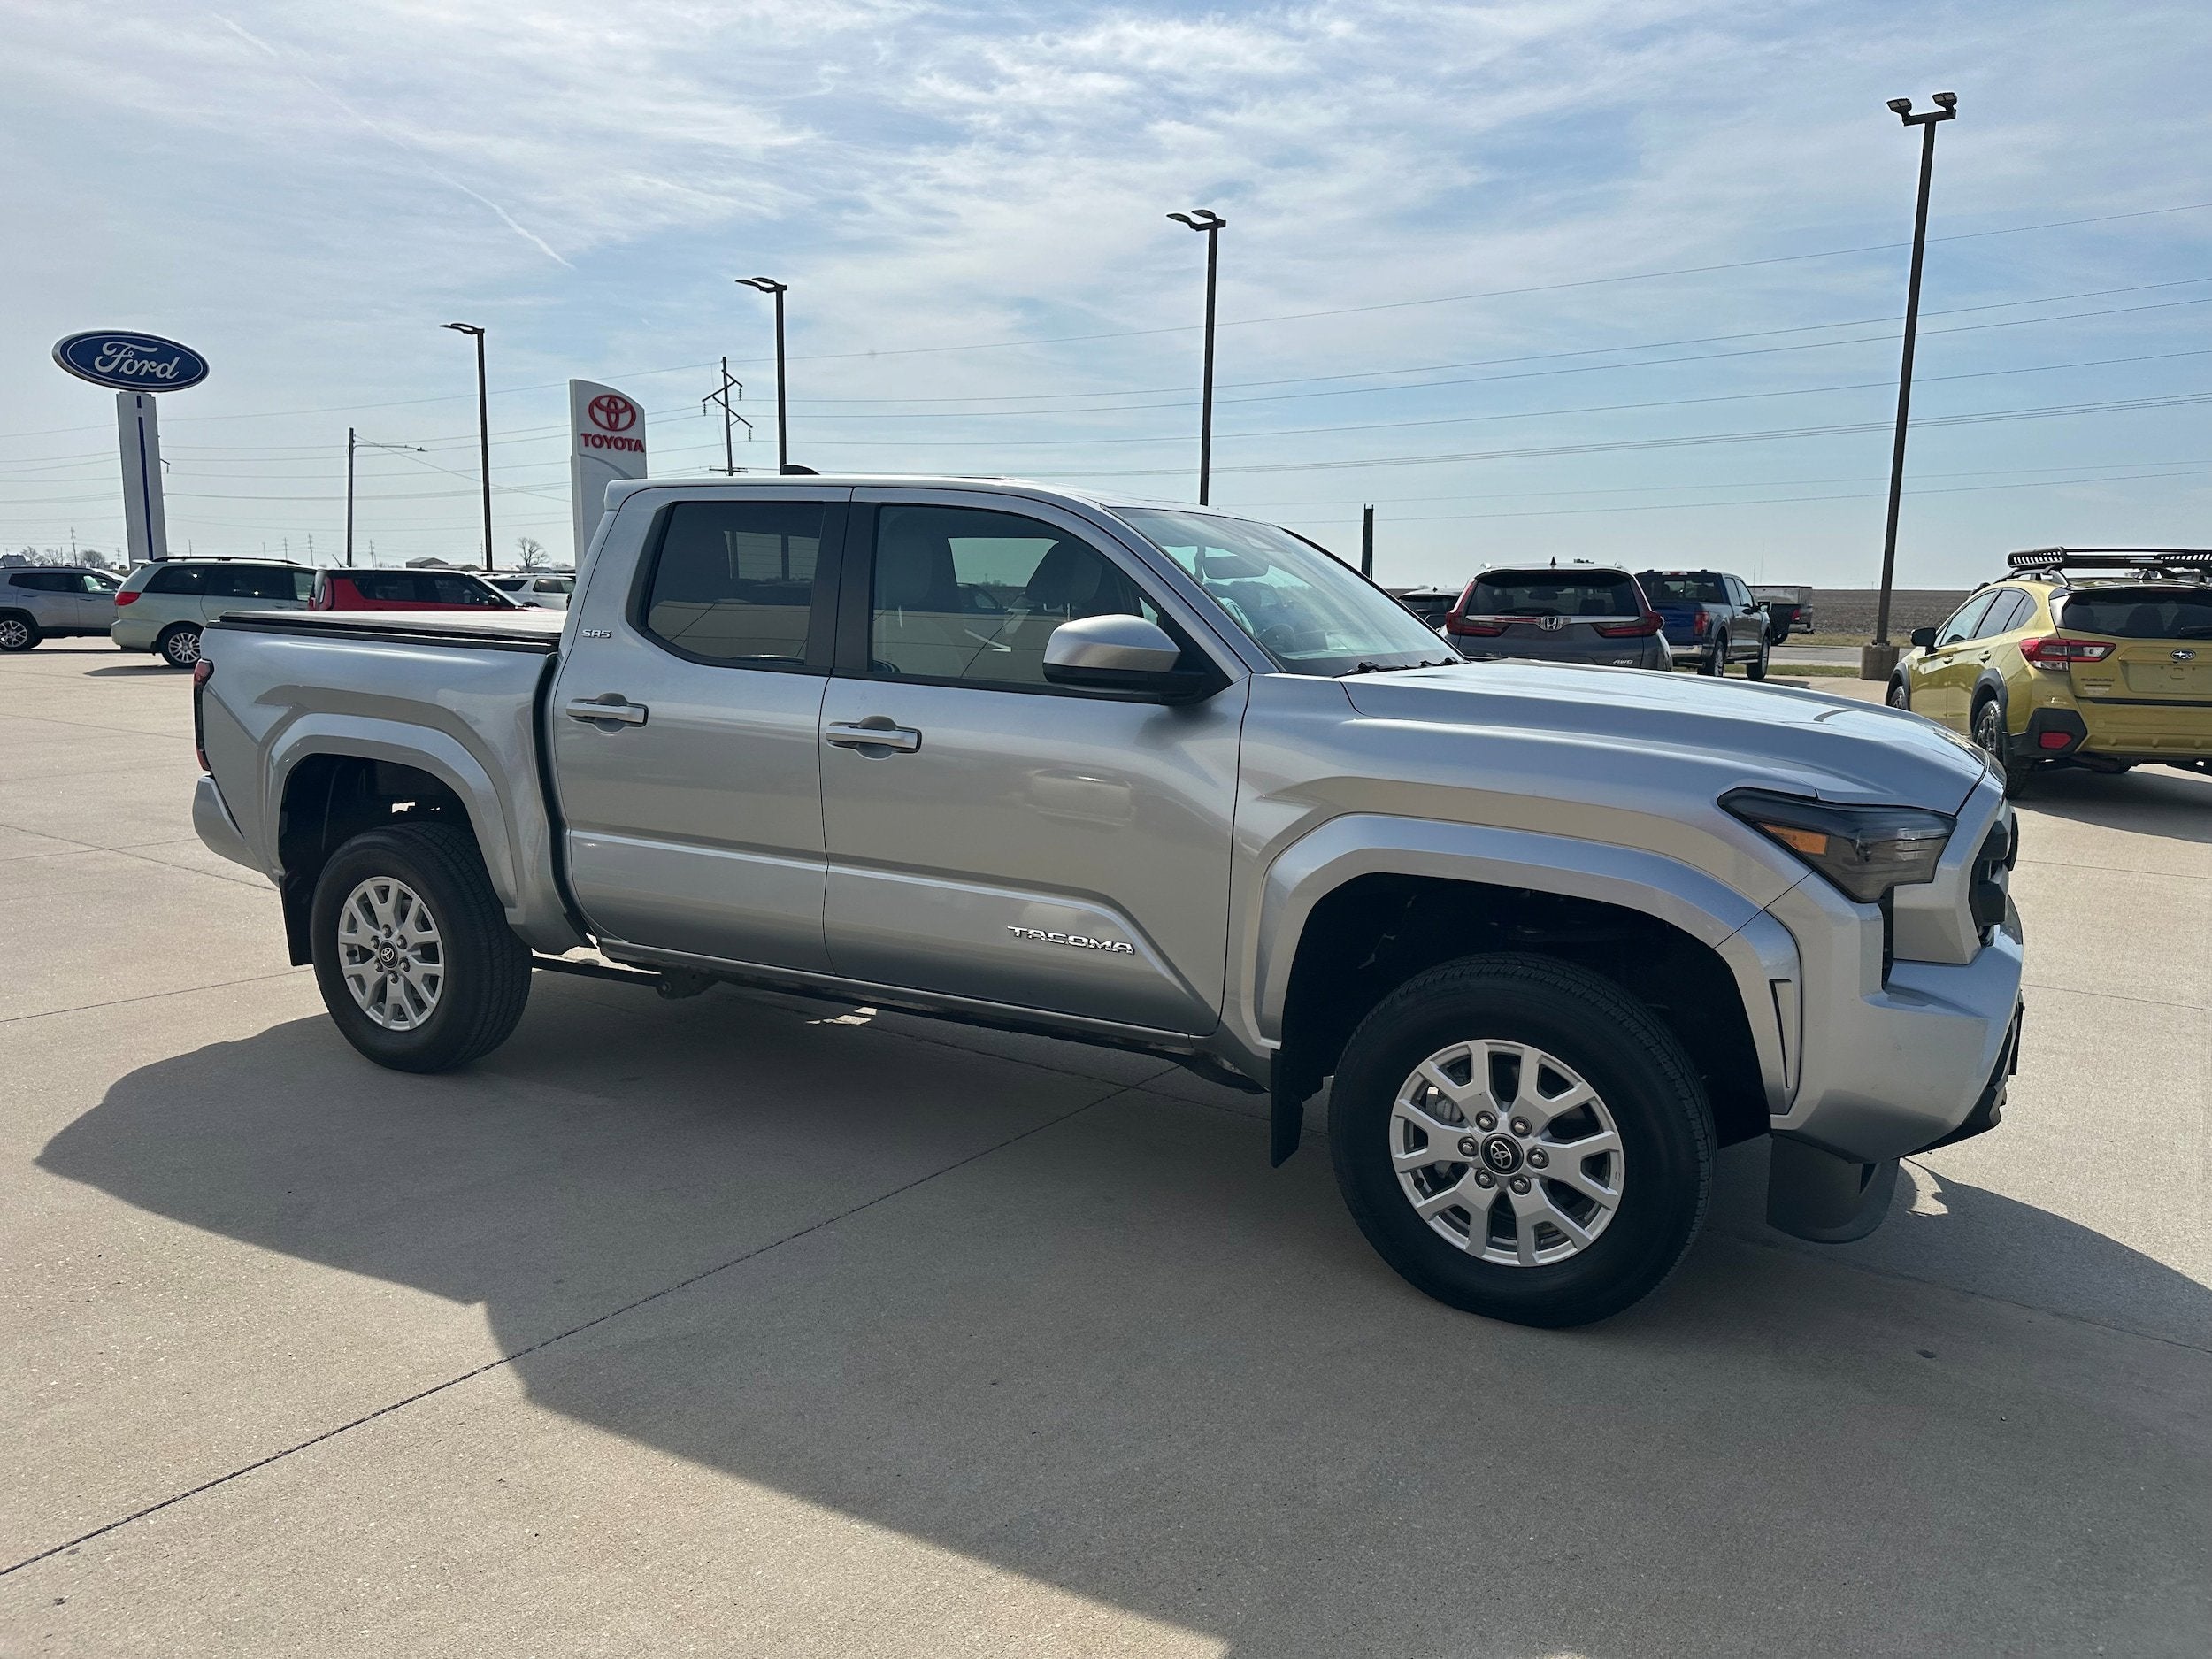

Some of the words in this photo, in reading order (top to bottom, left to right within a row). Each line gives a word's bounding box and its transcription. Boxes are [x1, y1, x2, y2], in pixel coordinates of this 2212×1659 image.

[94, 341, 180, 380] Ford
[580, 433, 645, 453] TOYOTA
[581, 629, 611, 638] SR5
[1007, 926, 1135, 955] TACOMA
